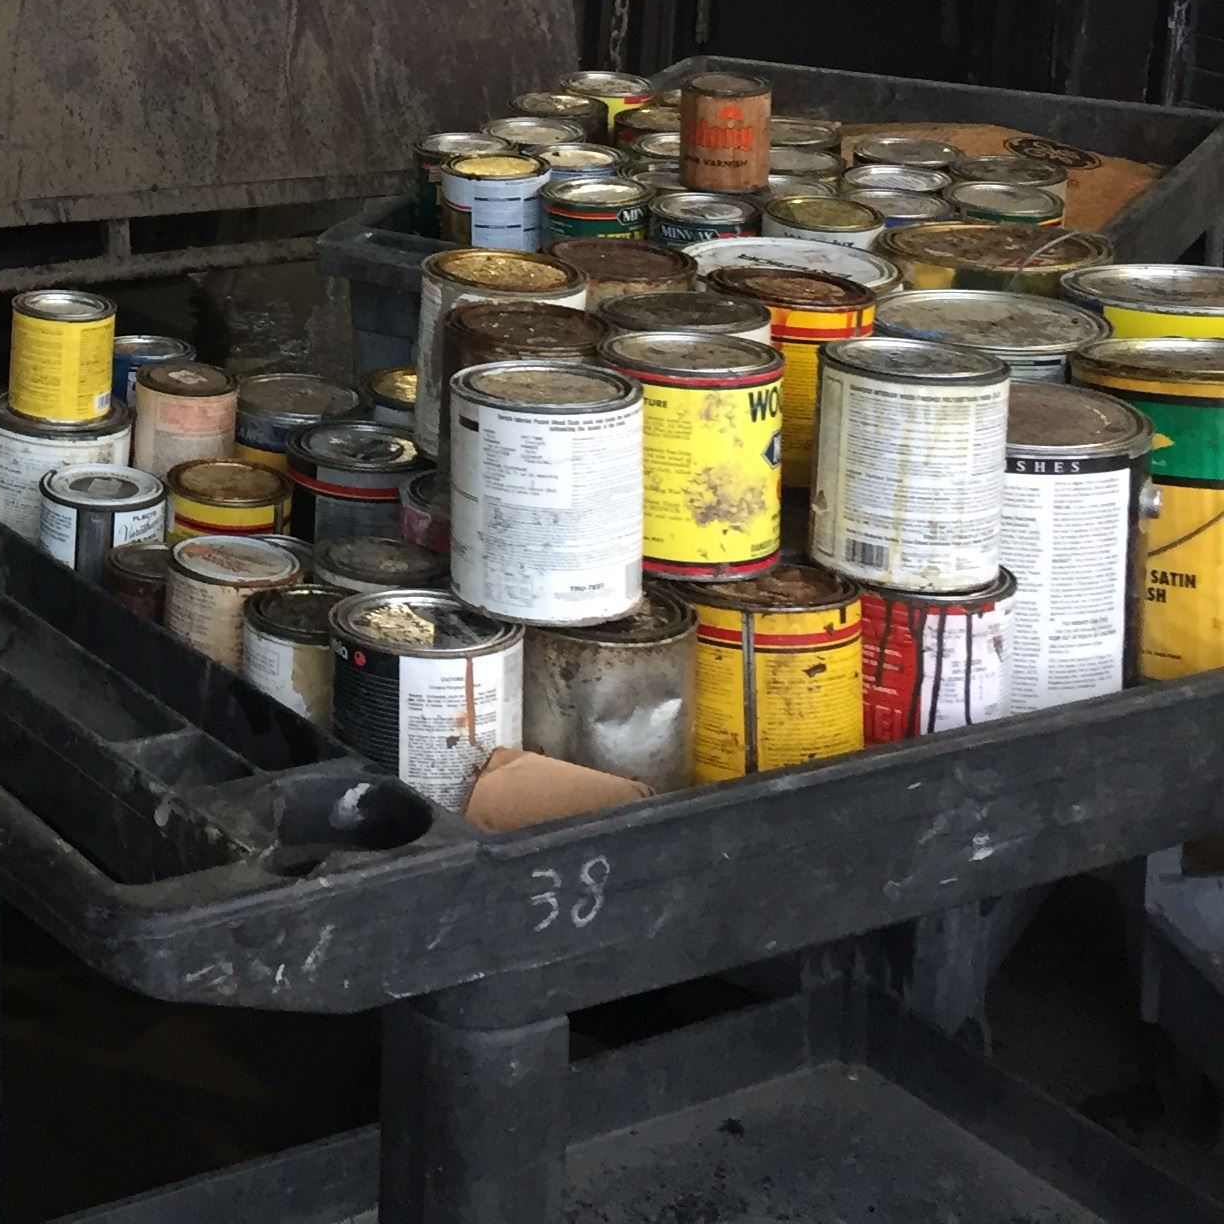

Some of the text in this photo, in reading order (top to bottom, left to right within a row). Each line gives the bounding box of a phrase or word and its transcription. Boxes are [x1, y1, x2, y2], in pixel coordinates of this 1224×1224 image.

[661, 224, 713, 240] MINWAX
[1150, 570, 1196, 588] SATIN
[530, 855, 611, 933] 38
